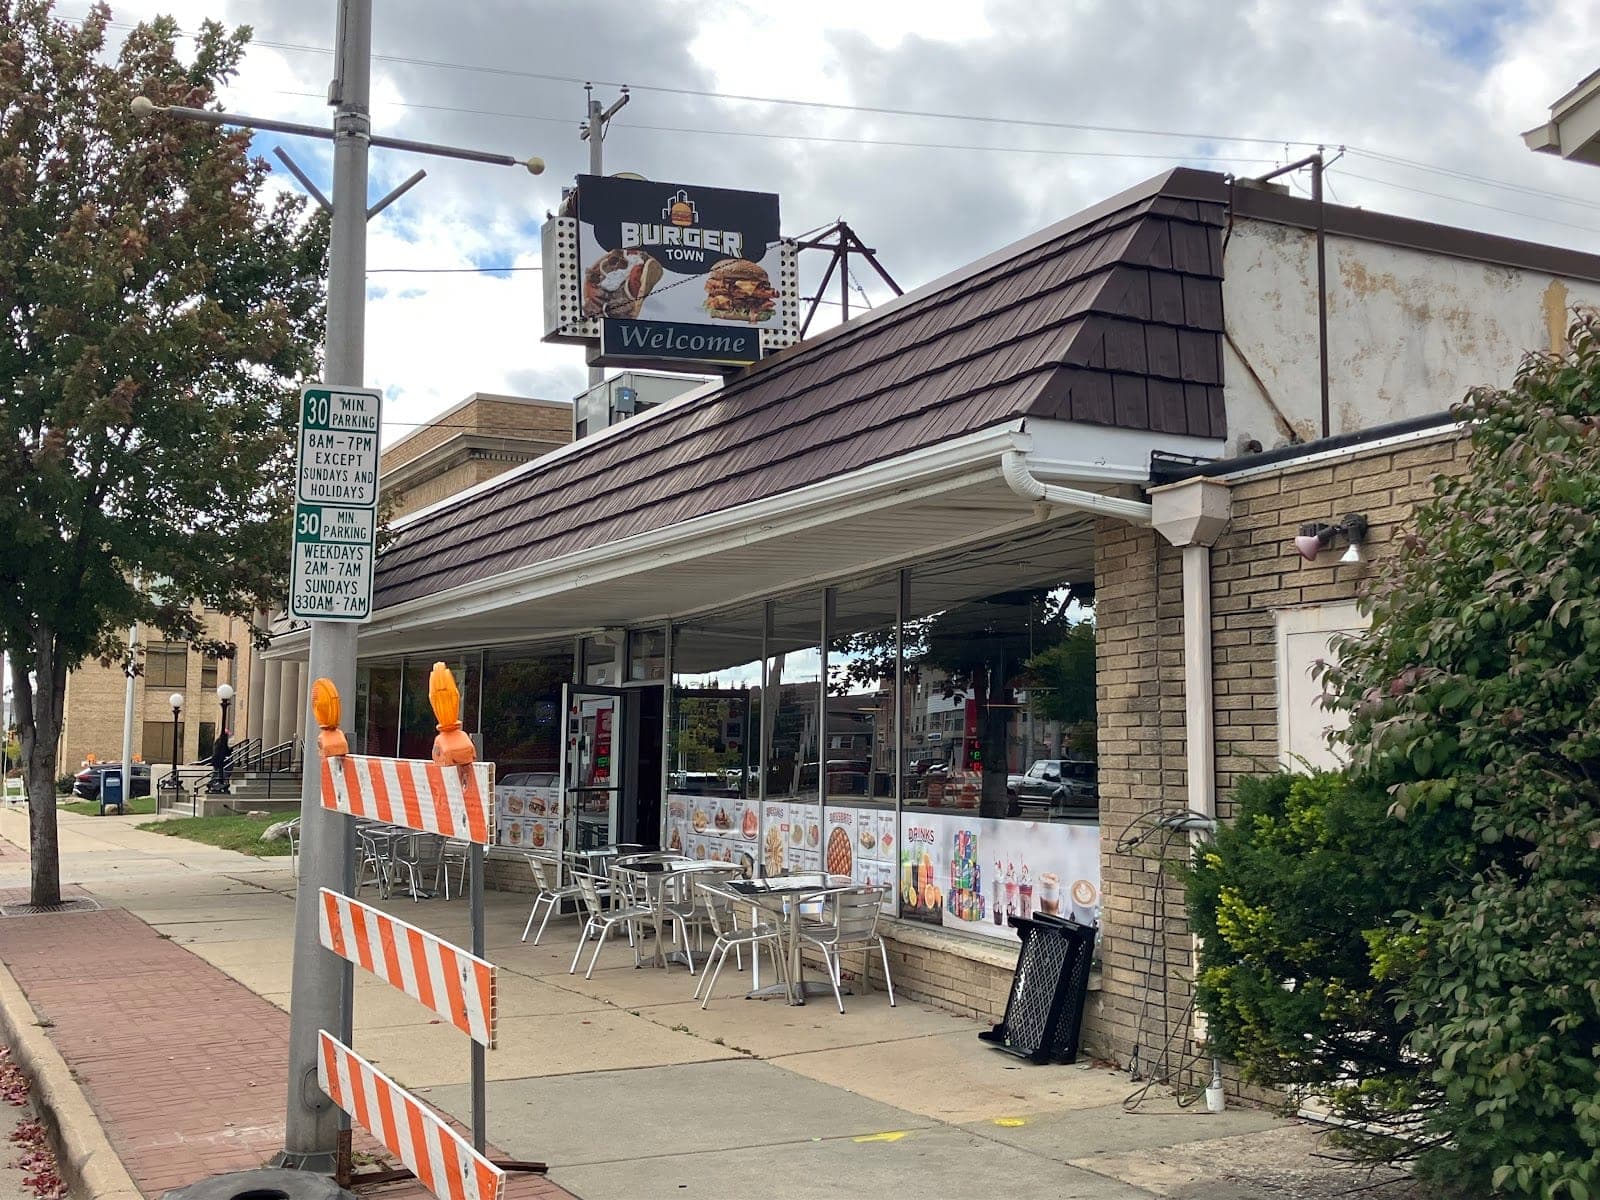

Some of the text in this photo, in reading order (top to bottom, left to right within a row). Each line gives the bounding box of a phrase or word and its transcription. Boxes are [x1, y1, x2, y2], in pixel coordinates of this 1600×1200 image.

[621, 222, 743, 258] BURGER
[665, 249, 704, 263] TOWN
[619, 325, 746, 353] Welcome
[307, 396, 328, 425] 30
[332, 413, 375, 429] PARKING
[315, 452, 363, 467] EXCEPT
[303, 467, 374, 484] SUNDAYS AND
[310, 483, 364, 499] HOLIDAYS
[297, 513, 319, 535] 30
[323, 525, 367, 540] PARKING
[304, 543, 363, 561] WEEKDAYS
[304, 579, 358, 595] SUNDAYS
[908, 827, 935, 845] DRINKS
